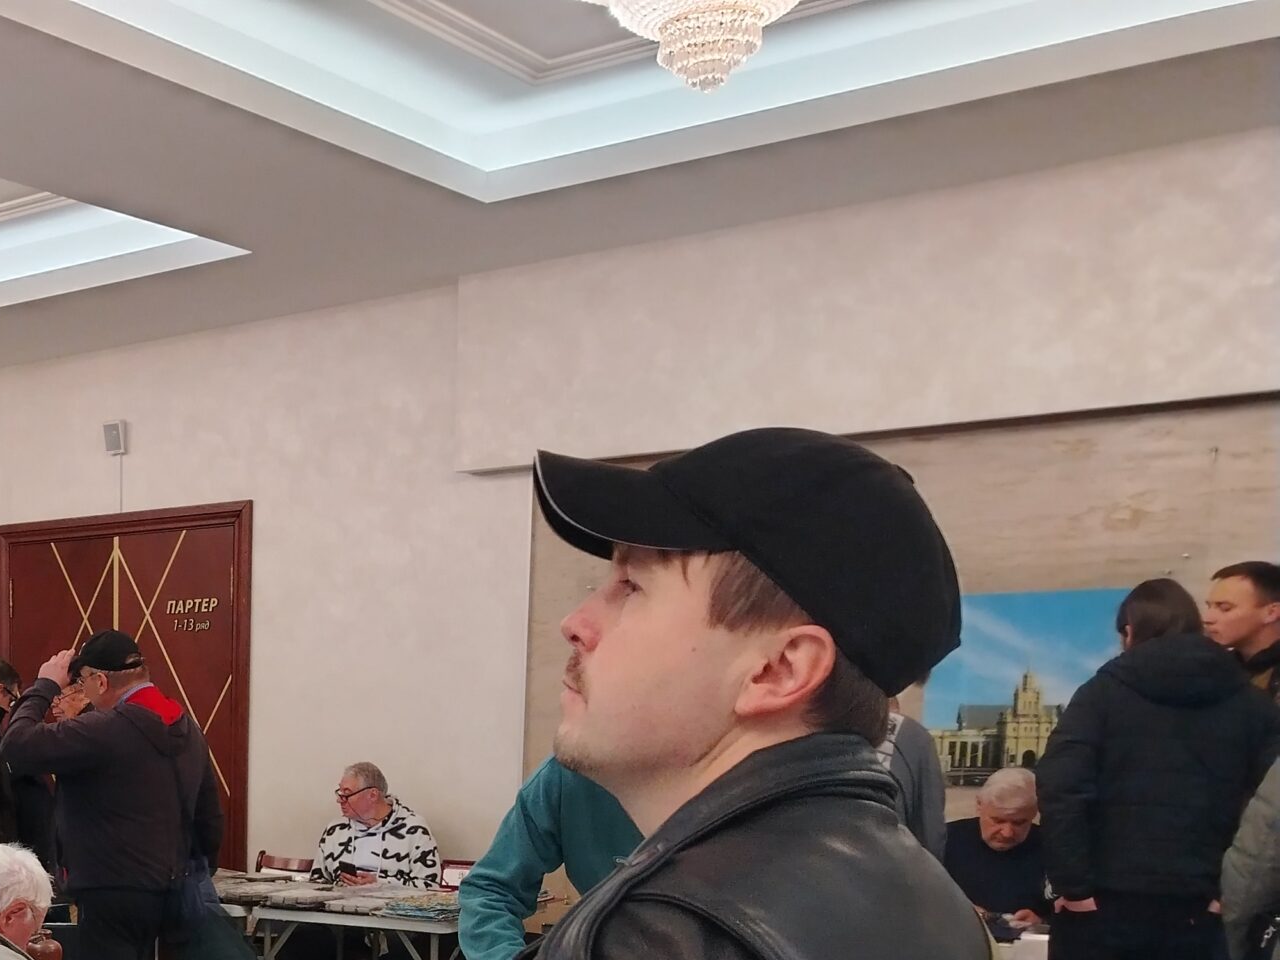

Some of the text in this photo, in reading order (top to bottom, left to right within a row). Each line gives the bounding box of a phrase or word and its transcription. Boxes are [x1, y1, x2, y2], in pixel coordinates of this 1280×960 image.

[166, 598, 219, 614] ПАРТЕР
[174, 618, 210, 632] 1-13 ряд
